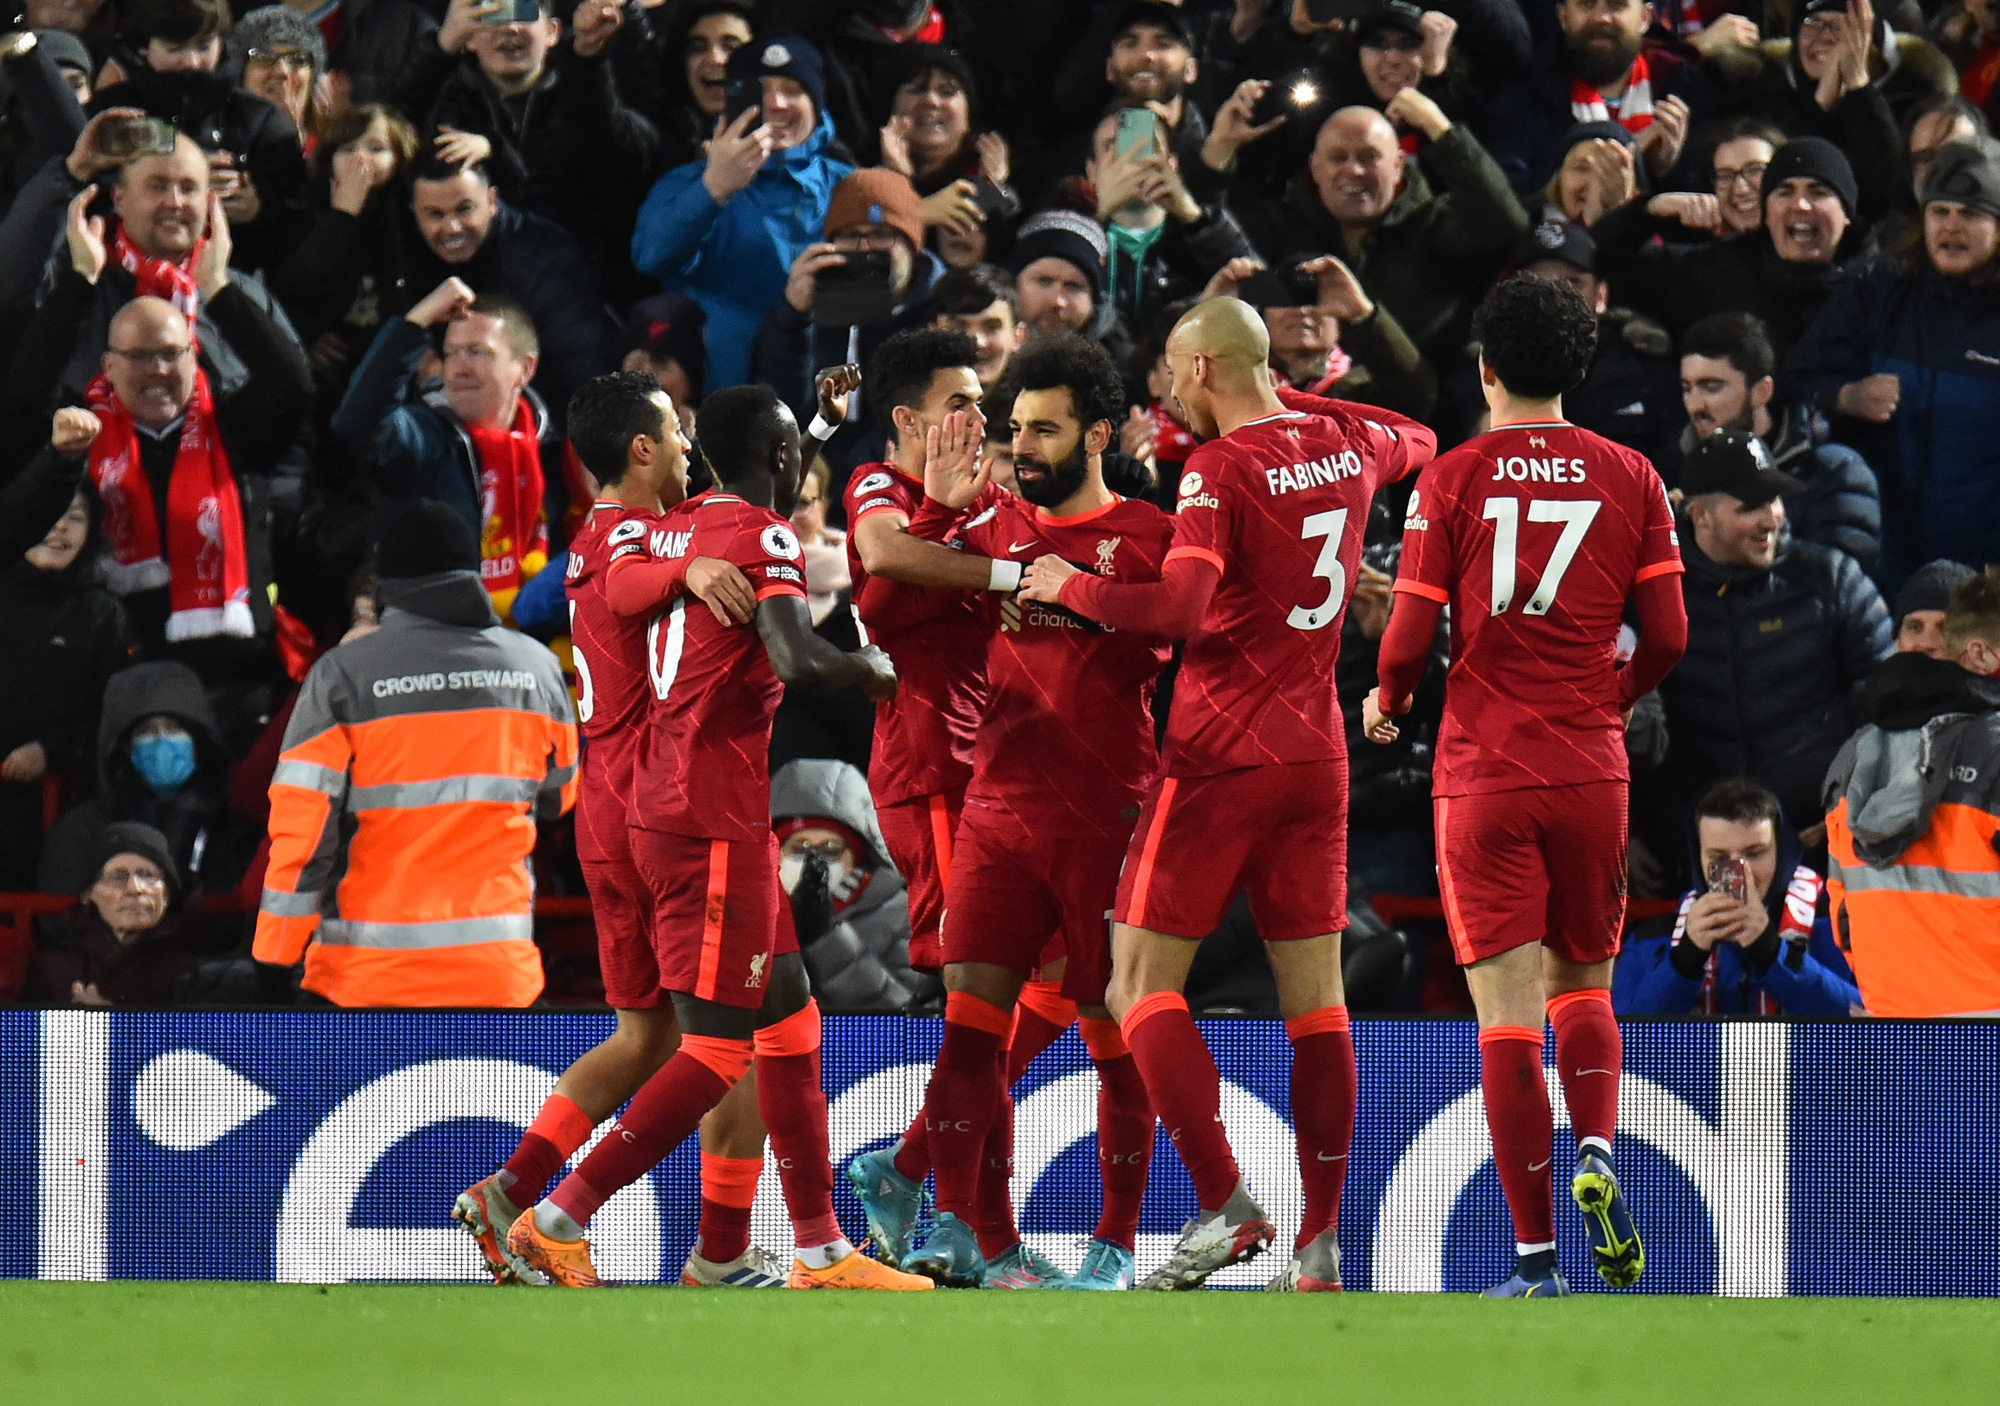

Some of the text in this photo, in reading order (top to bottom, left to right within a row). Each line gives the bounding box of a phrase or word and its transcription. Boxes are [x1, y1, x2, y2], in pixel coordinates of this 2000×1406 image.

[1265, 450, 1362, 496] FABINHO
[1491, 456, 1587, 483] JONES
[650, 524, 696, 558] MANÉ
[1482, 496, 1602, 617] 17
[1286, 508, 1348, 631] 3
[372, 669, 537, 698] CROWD STEWARD
